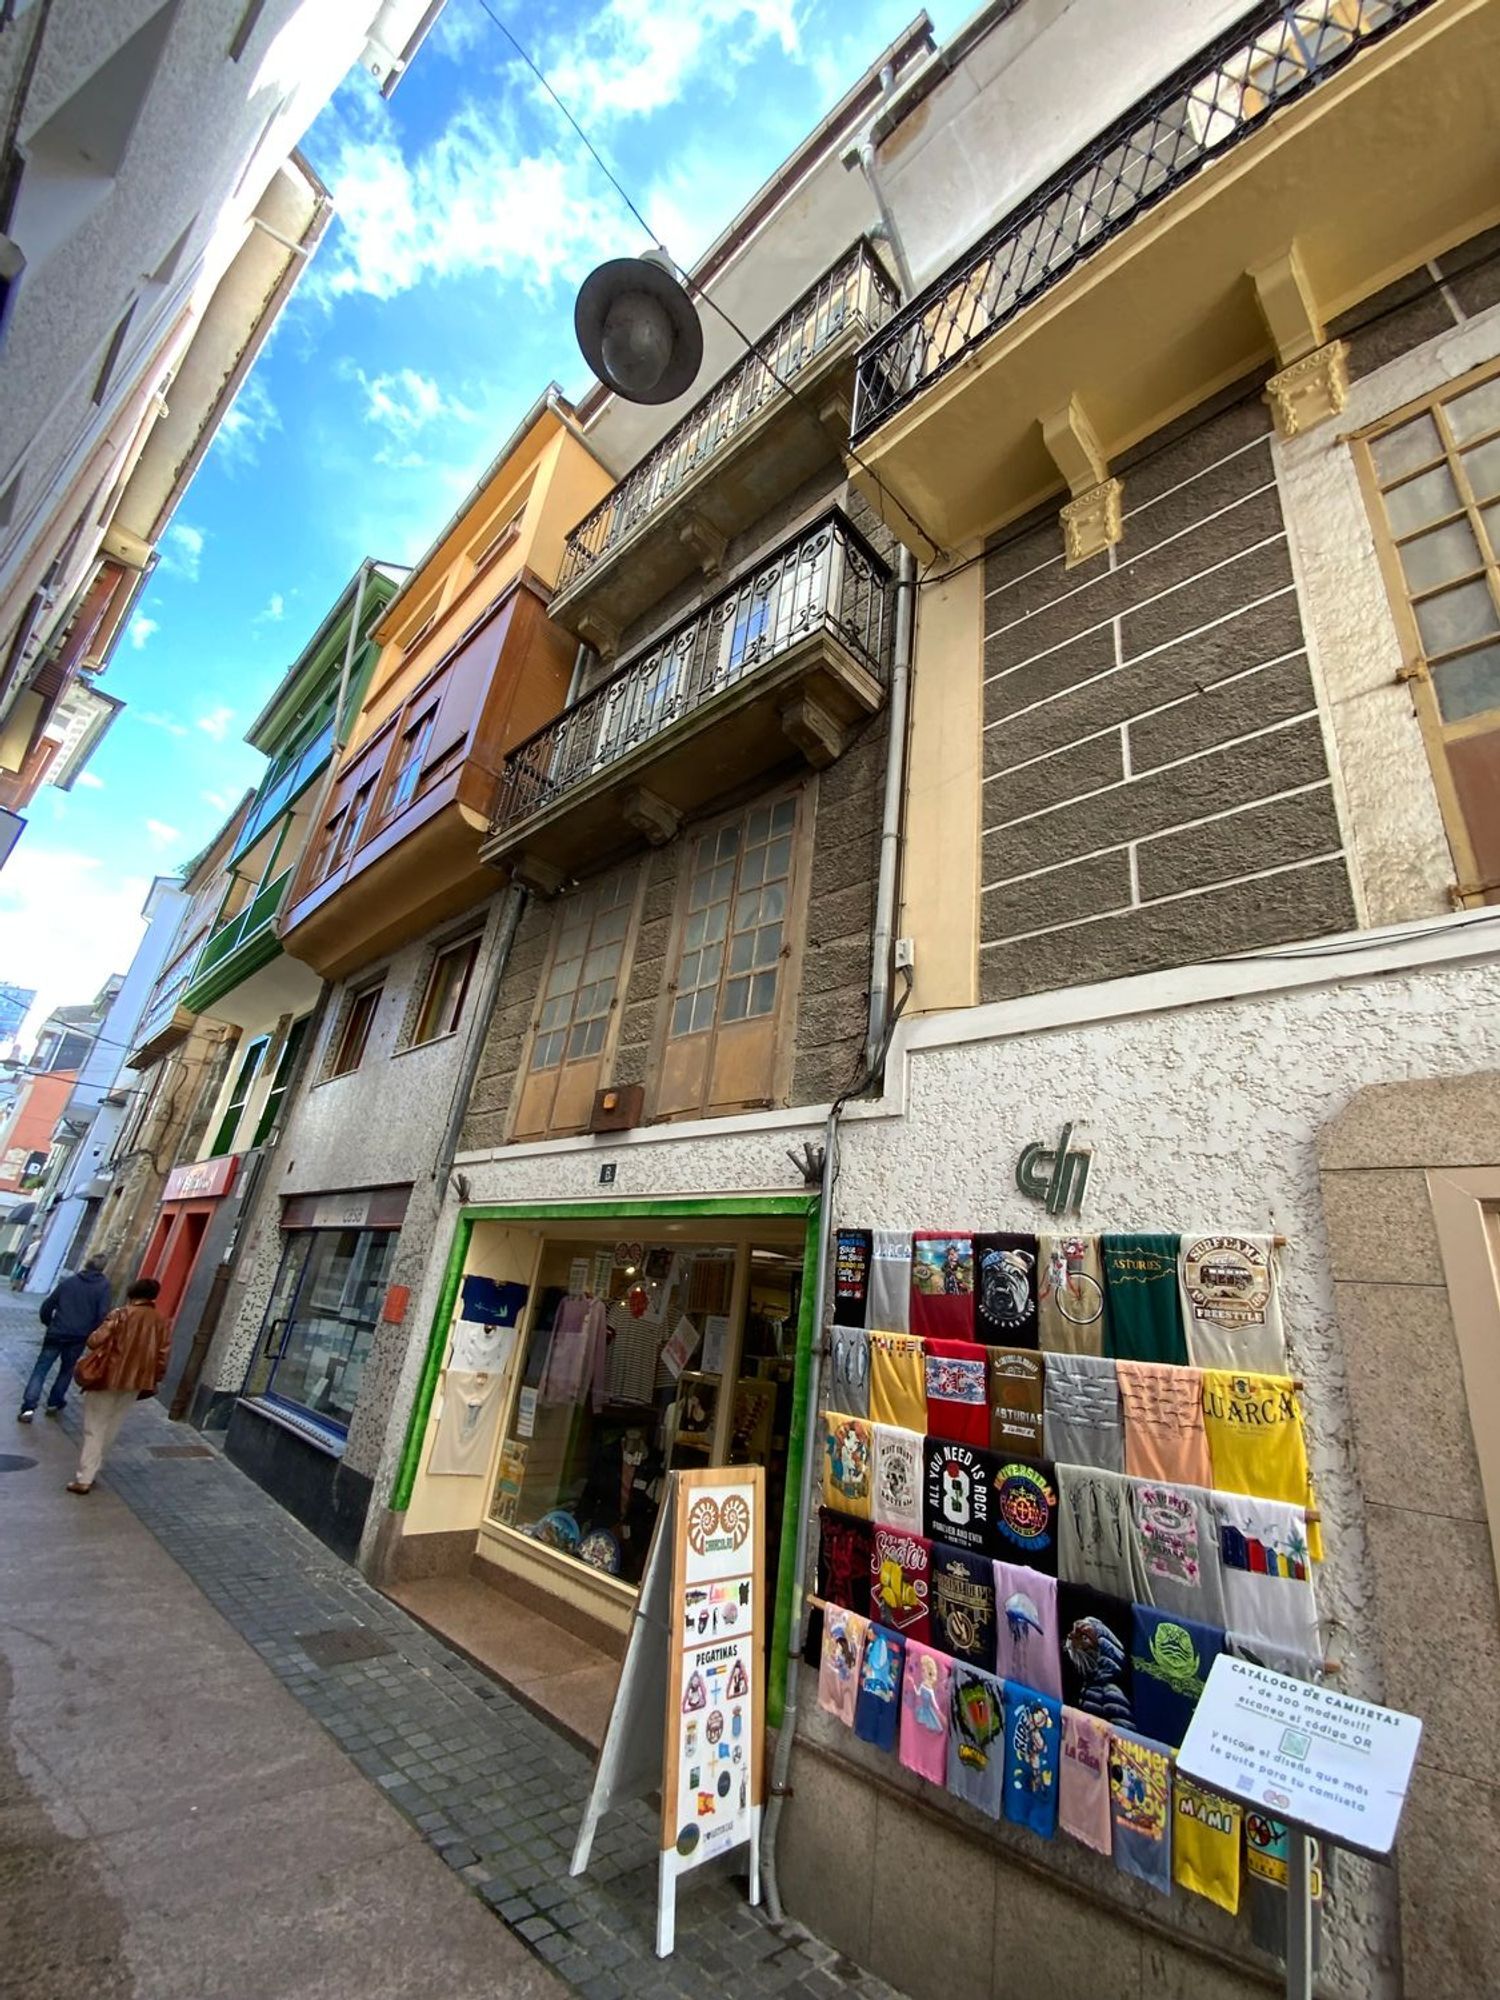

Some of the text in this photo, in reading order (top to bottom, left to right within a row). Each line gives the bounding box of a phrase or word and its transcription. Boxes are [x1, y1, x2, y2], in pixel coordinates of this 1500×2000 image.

[1112, 1258, 1162, 1270] ASTURIES
[1197, 1308, 1263, 1322] FREESTYLE
[995, 1407, 1043, 1425] ASTURIAS
[1201, 1386, 1295, 1425] LUARCA
[930, 1446, 987, 1521] ALL YOU NEED IS ROCK
[696, 1645, 738, 1667] PEGATINAS
[1231, 1664, 1297, 1692] CATÁLOGO
[1303, 1688, 1320, 1700] DE
[1325, 1696, 1400, 1726] CAMISETAS
[1258, 1687, 1272, 1698] de
[1238, 1695, 1372, 1748] escanea el código QR
[1210, 1743, 1221, 1754] te
[1259, 1765, 1287, 1782] para
[1291, 1776, 1305, 1788] tu
[1309, 1785, 1366, 1812] camiseta
[1259, 1748, 1270, 1758] el
[1274, 1755, 1311, 1774] diseño
[1315, 1770, 1339, 1786] que
[1343, 1780, 1368, 1796] más
[1178, 1797, 1232, 1835] MAMI
